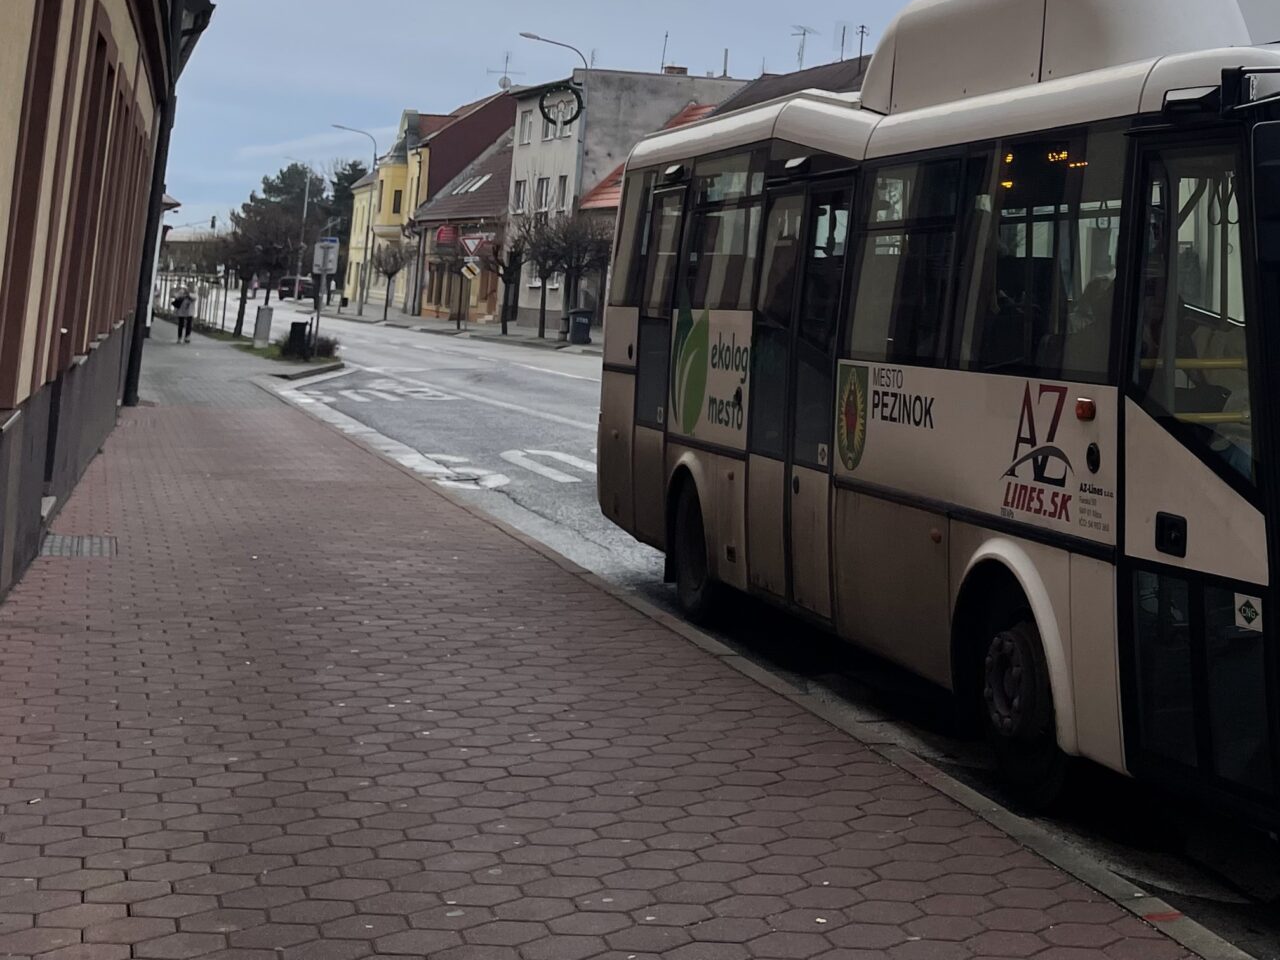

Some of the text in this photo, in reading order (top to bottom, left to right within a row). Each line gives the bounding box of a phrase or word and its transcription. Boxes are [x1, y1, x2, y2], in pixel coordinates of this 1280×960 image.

[711, 333, 750, 384] ekolog
[872, 367, 904, 389] MESTO
[708, 393, 744, 431] mesto
[872, 390, 935, 429] PEZINOK
[1006, 380, 1068, 488] AZ
